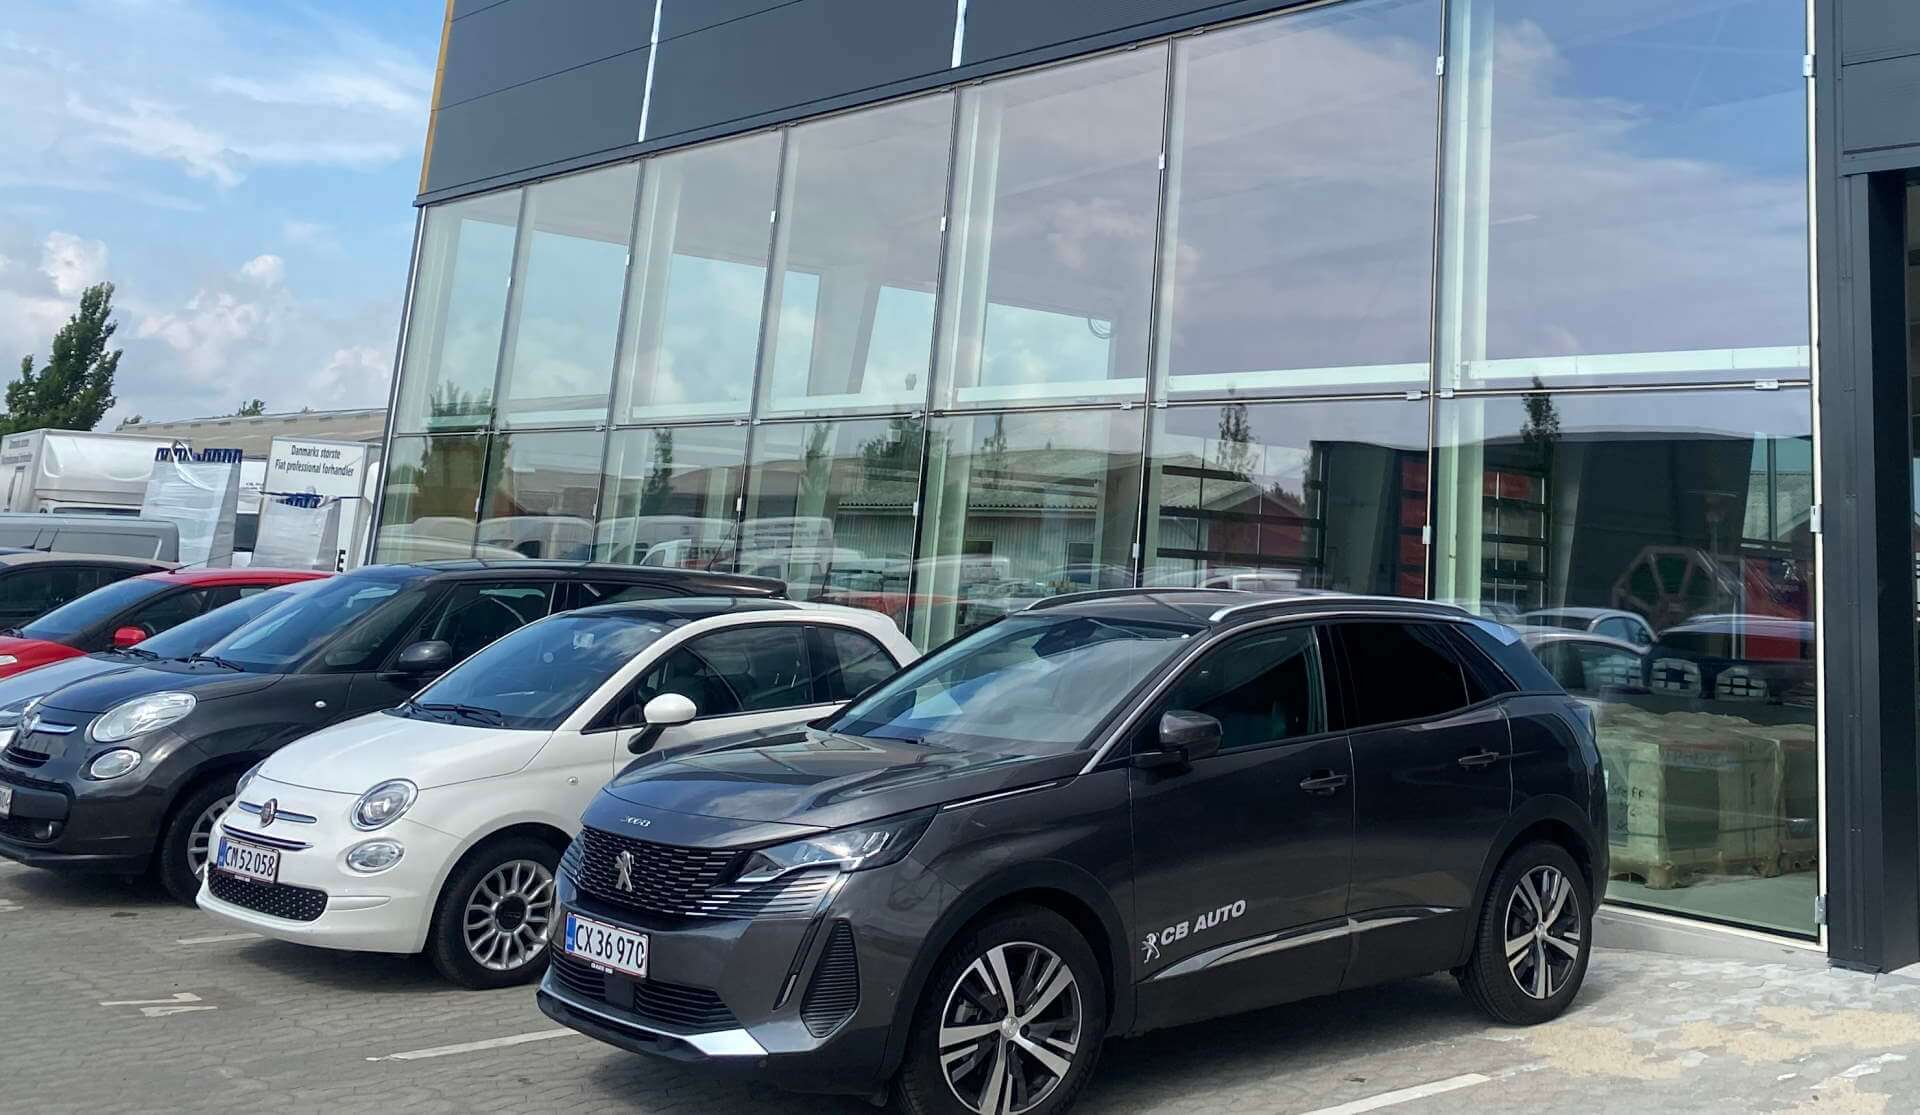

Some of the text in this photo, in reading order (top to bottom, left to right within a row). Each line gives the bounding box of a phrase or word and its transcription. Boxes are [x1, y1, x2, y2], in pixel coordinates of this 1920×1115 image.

[291, 445, 319, 458] Danmarks
[274, 459, 354, 476] Fiat professional forhandler
[239, 849, 253, 871] 52
[254, 853, 275, 876] 058
[1160, 899, 1247, 946] CB AUTO
[576, 925, 592, 954] CX
[596, 930, 612, 959] 36
[617, 937, 645, 969] 970
